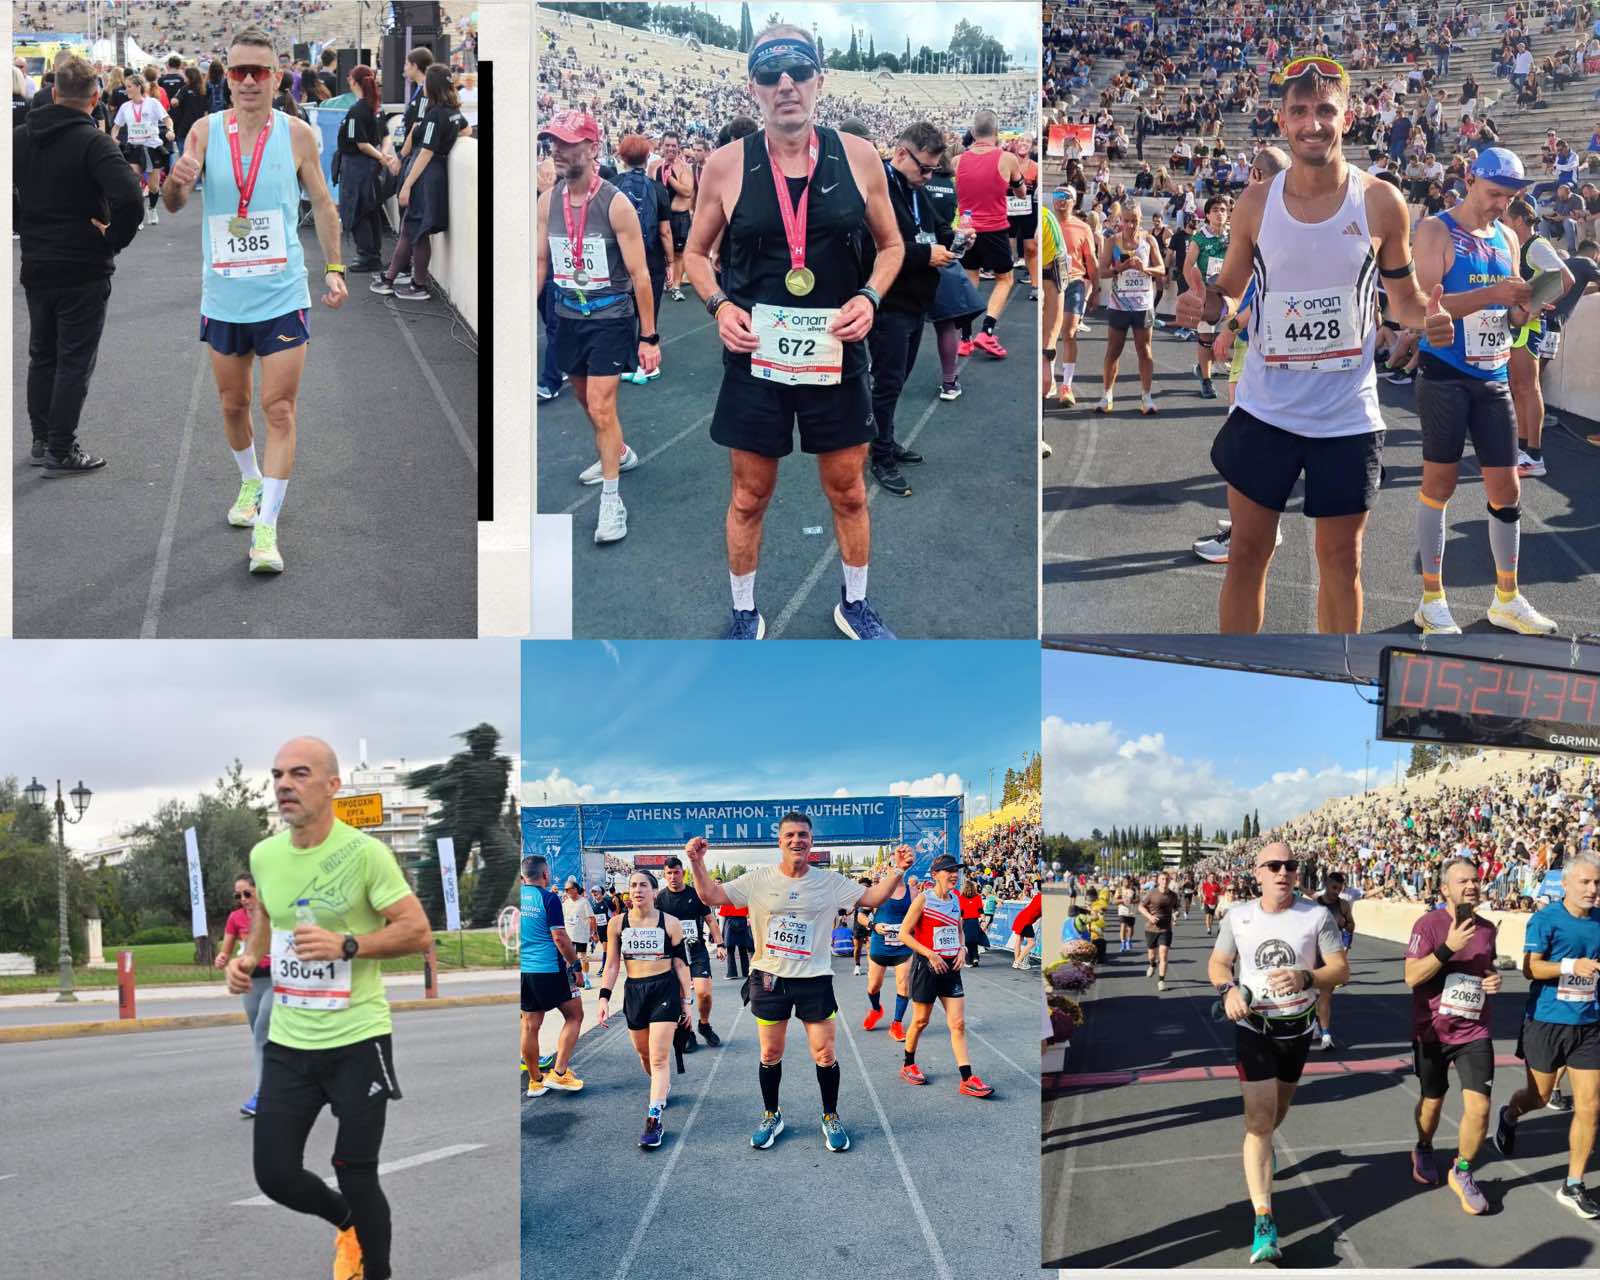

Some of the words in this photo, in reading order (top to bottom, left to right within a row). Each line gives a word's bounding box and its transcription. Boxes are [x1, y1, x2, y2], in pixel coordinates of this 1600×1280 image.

[227, 235, 270, 253] 1385
[1285, 319, 1341, 342] 4428
[778, 337, 817, 357] 672
[1401, 656, 1599, 723] 05:24:39
[626, 808, 682, 821] ATHENS
[686, 805, 769, 820] MARATHON.
[773, 804, 800, 818] THE
[805, 802, 884, 817] AUTHENTIC
[915, 808, 946, 819] 2025
[536, 818, 565, 829] 2025
[628, 940, 659, 949] 19555
[773, 930, 806, 946] 16511
[1450, 989, 1481, 1004] 20629
